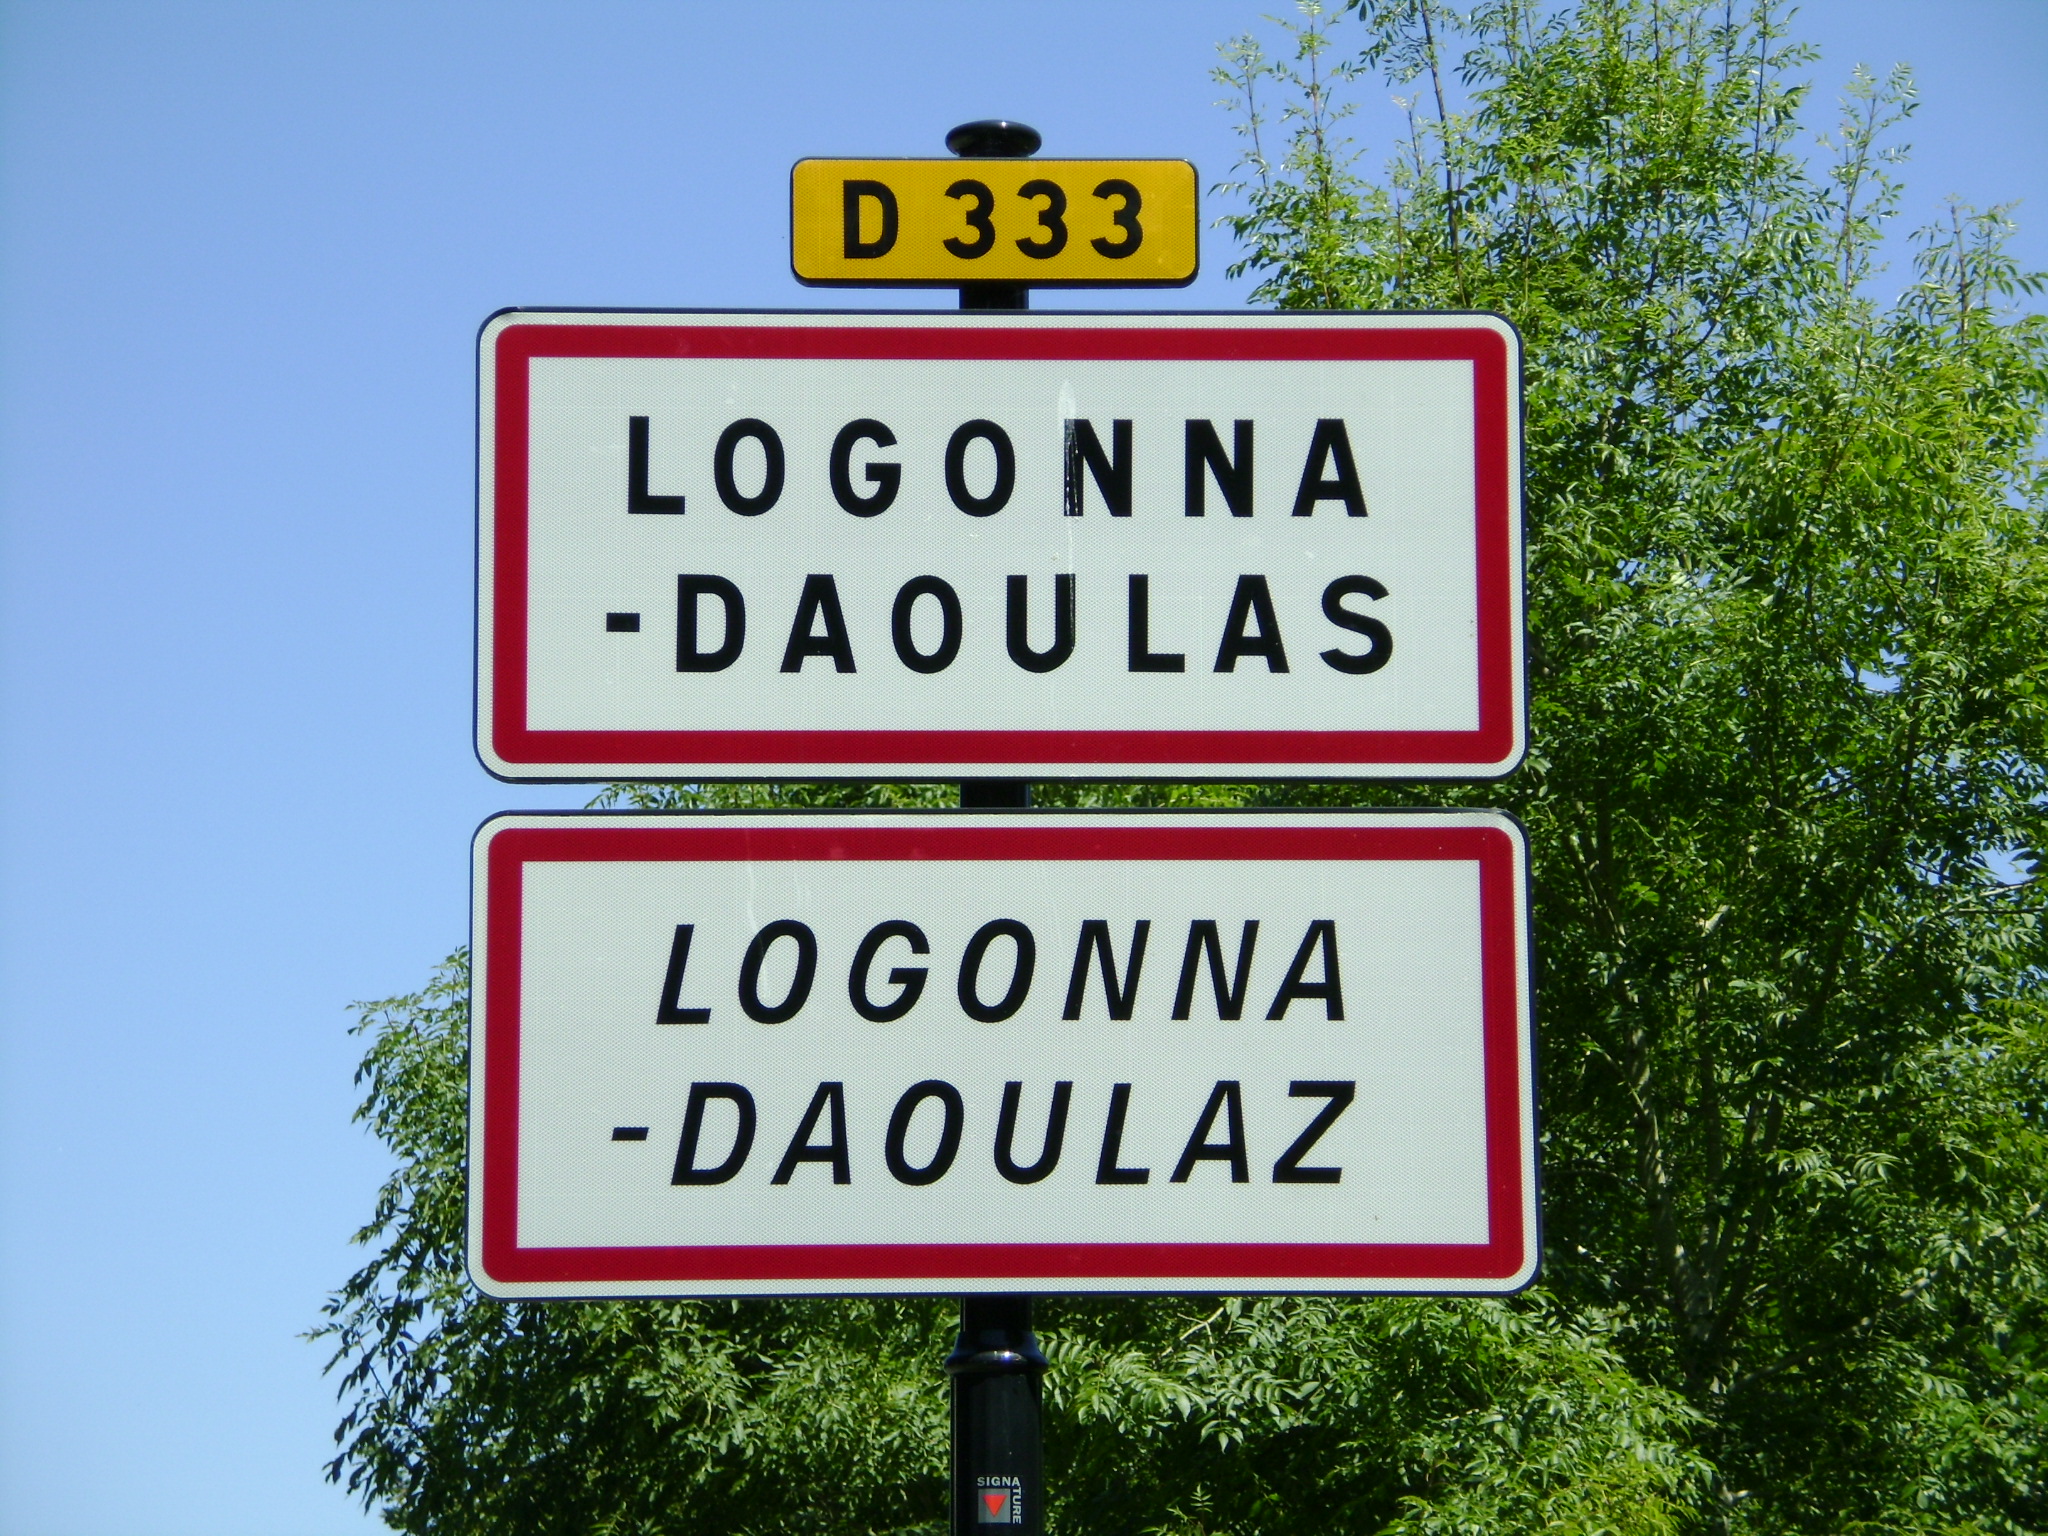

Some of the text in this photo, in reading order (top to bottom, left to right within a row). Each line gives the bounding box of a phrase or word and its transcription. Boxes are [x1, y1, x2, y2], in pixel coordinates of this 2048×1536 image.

[842, 178, 1144, 261] D 333
[627, 415, 1368, 518] LOGONNA
[605, 573, 1393, 675] -DAOULAS
[655, 918, 1345, 1025] LOGONNA
[611, 1079, 1356, 1187] -DAOULAZ
